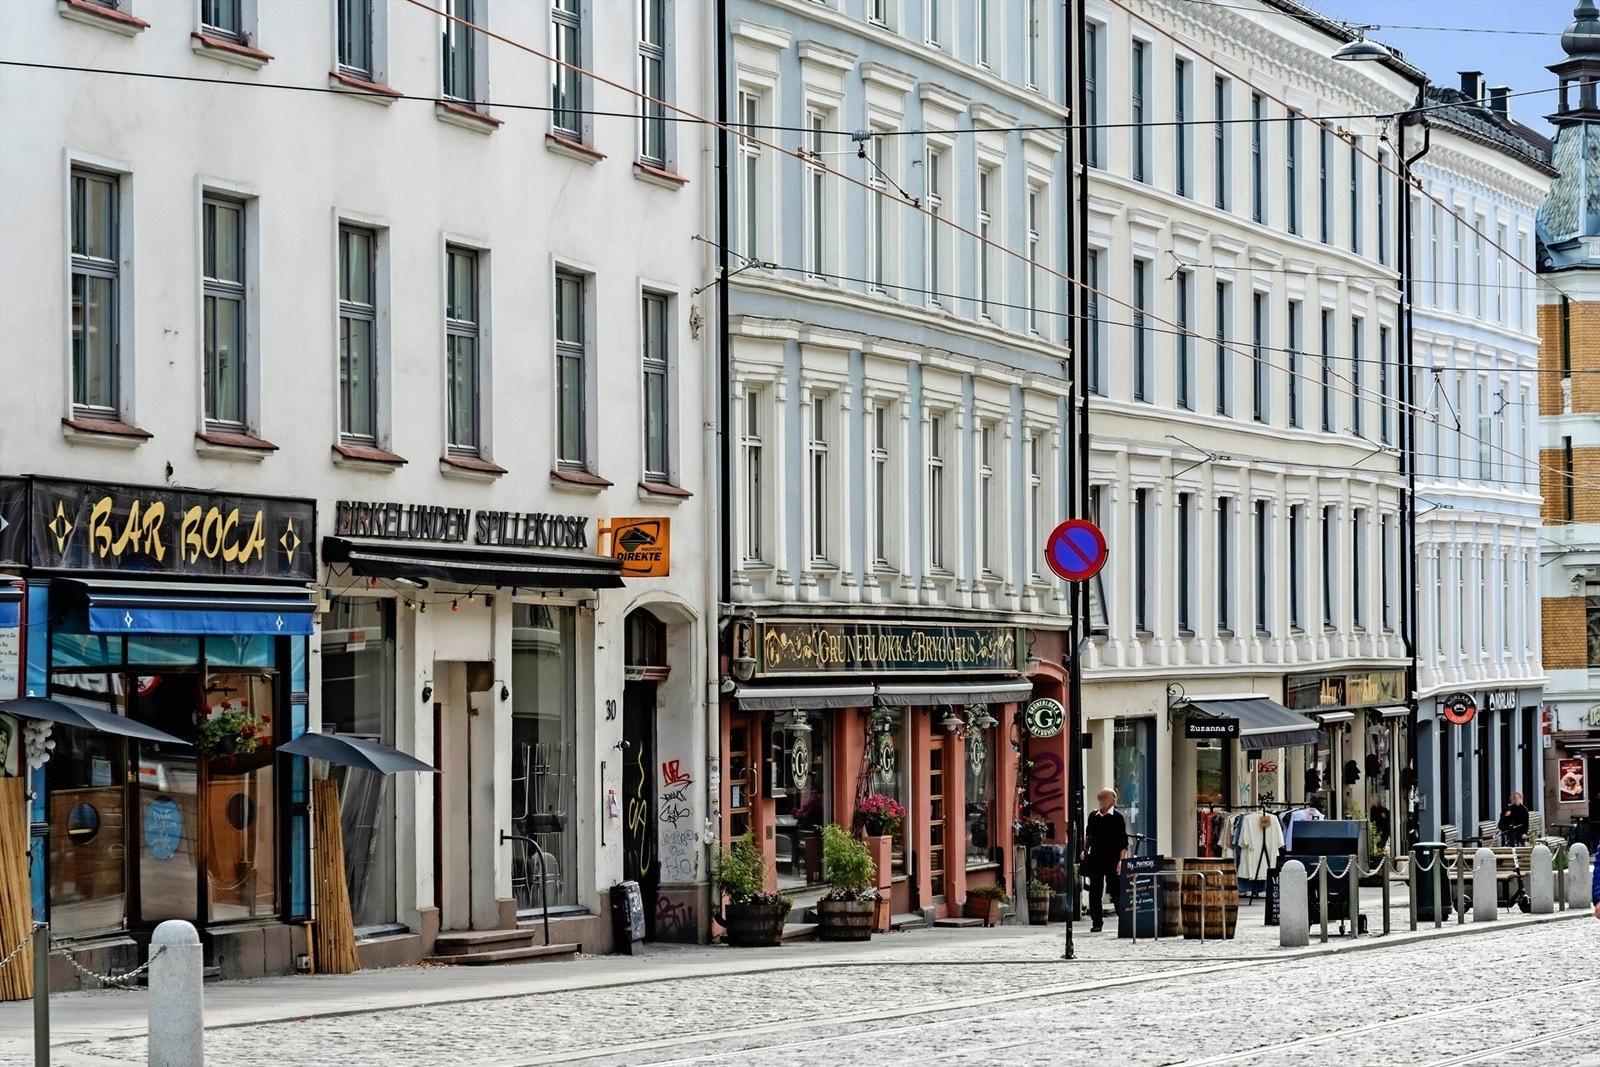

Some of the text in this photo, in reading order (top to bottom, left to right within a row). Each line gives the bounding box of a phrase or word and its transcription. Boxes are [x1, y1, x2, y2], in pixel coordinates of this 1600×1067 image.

[90, 496, 266, 565] BAR BOCA
[335, 500, 589, 549] BIRKELUNDEN SPILLEKIOSK
[617, 552, 661, 562] DIREKTE
[917, 630, 977, 664] BRYGGHUS
[605, 699, 617, 721] 30
[1447, 694, 1473, 706] NORLAKS
[1034, 708, 1054, 728] G
[1190, 724, 1234, 732] Zuzanna G
